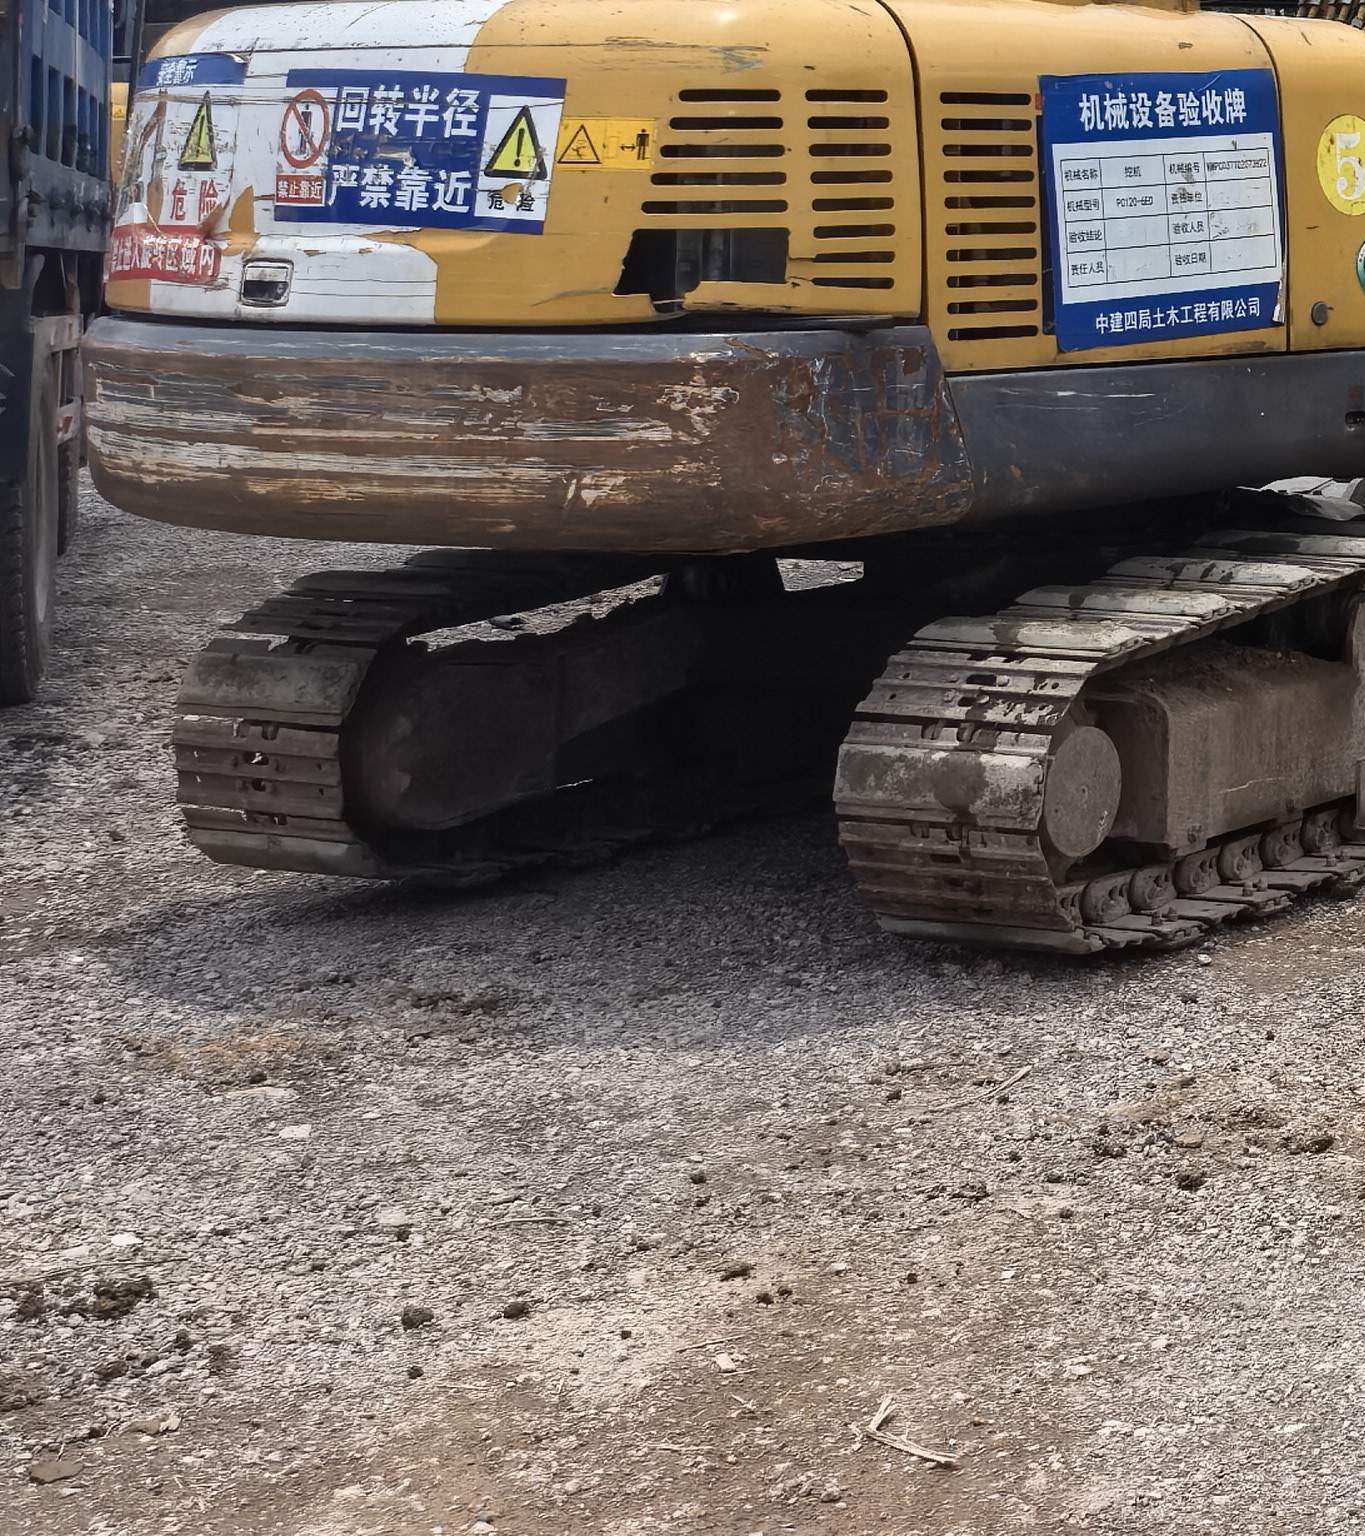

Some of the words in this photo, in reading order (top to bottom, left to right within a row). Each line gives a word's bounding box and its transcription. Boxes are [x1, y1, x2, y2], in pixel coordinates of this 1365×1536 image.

[335, 84, 481, 138] 回转半径
[1078, 88, 1248, 132] 机械设备验收牌
[276, 181, 324, 204] 禁止靠近
[328, 163, 474, 214] 严禁靠近
[1095, 297, 1261, 335] 中建四局土木工程有限公司
